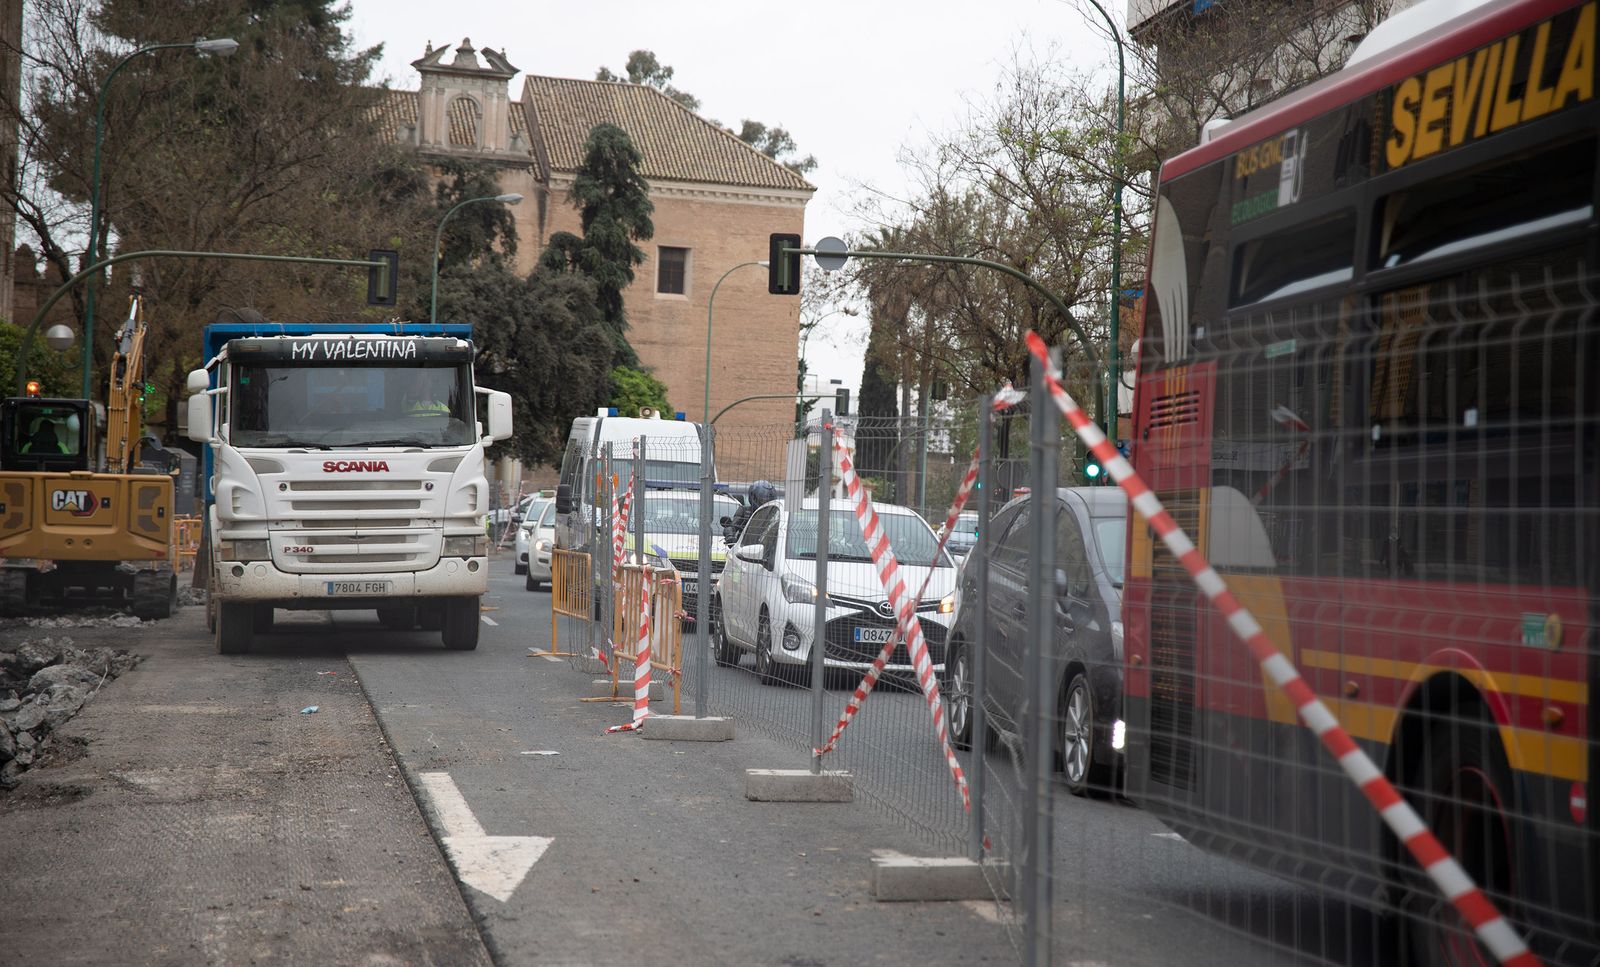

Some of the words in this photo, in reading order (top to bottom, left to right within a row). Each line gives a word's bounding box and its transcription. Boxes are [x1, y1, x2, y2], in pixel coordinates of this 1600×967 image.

[1386, 2, 1596, 168] SEVILLA
[1236, 145, 1258, 179] BUS
[292, 341, 319, 359] MY
[323, 340, 416, 359] VALENTINA
[322, 461, 390, 473] SCANIA
[52, 490, 88, 511] CAT
[283, 546, 291, 554] P
[292, 546, 314, 554] 340
[335, 583, 362, 593] 7804
[365, 583, 386, 593] FGH
[863, 629, 892, 642] 0847
